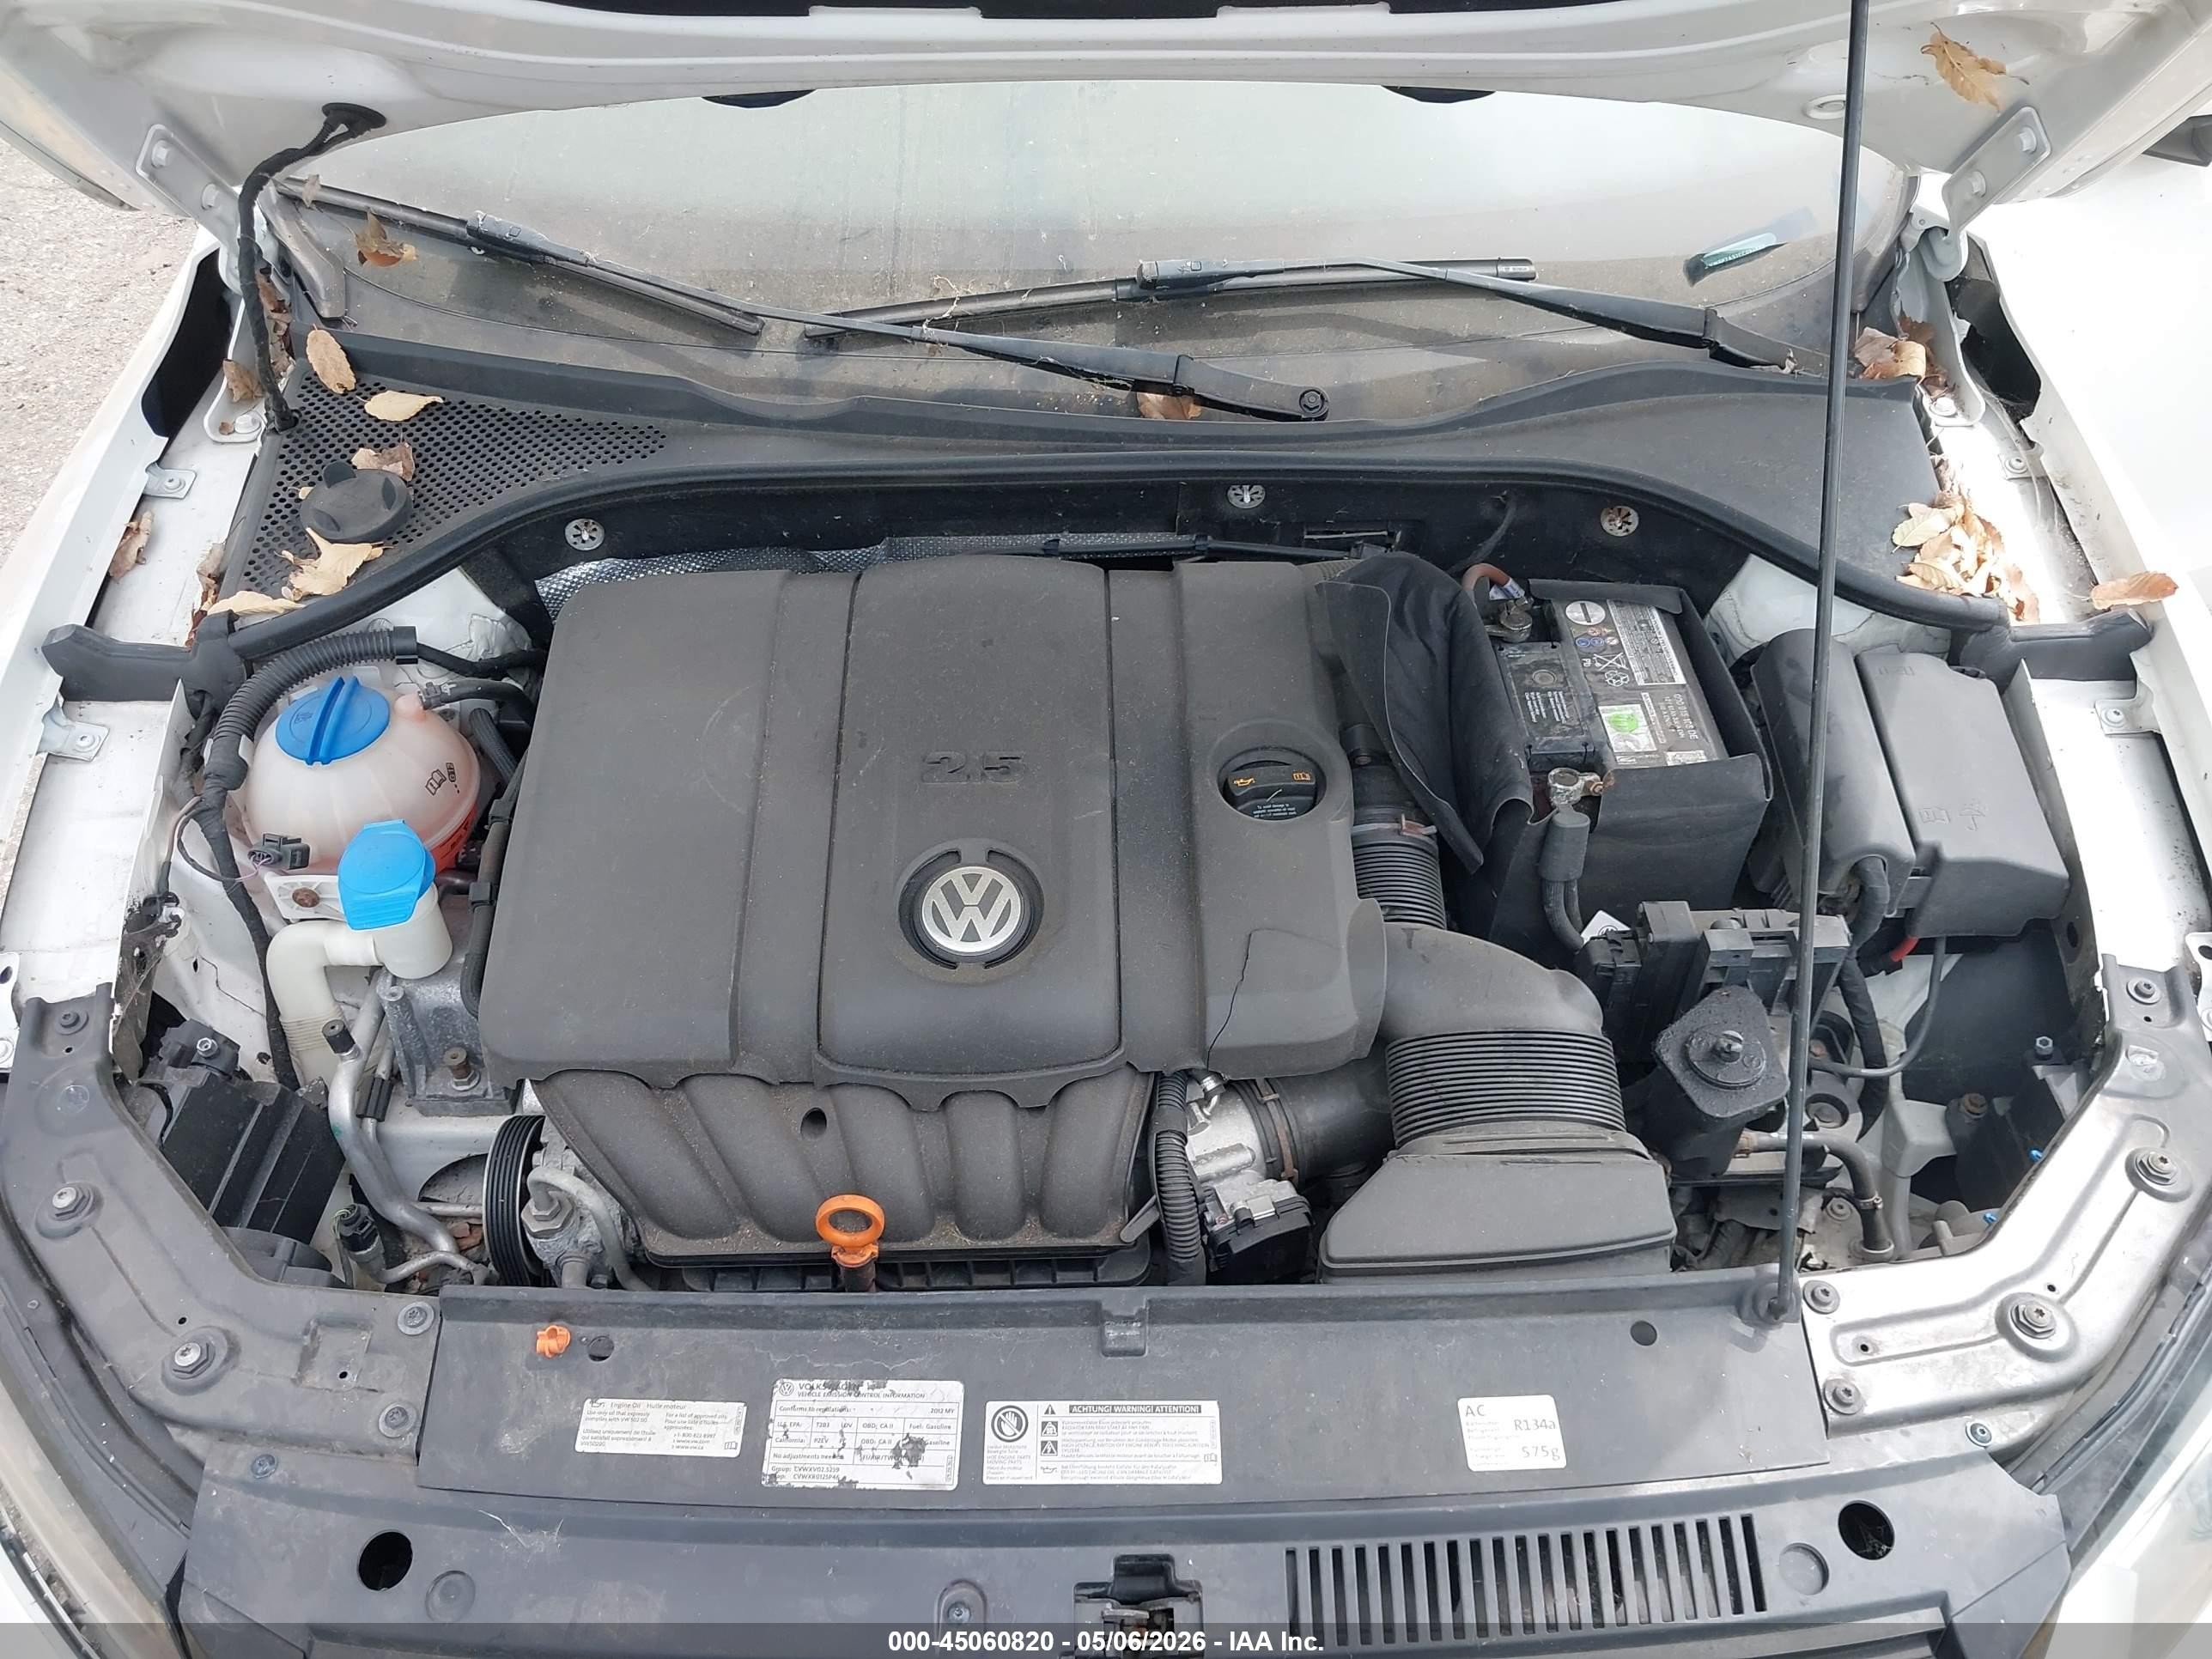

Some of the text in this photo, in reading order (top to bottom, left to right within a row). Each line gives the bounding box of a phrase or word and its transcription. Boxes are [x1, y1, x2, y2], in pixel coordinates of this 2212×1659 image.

[921, 750, 1024, 784] 2.5
[1072, 1405, 1200, 1413] ACHTUNG! WARNING! ATTENTION!
[1465, 1403, 1485, 1417] AC
[1514, 1418, 1556, 1431] R134a
[1522, 1444, 1560, 1462] 575g
